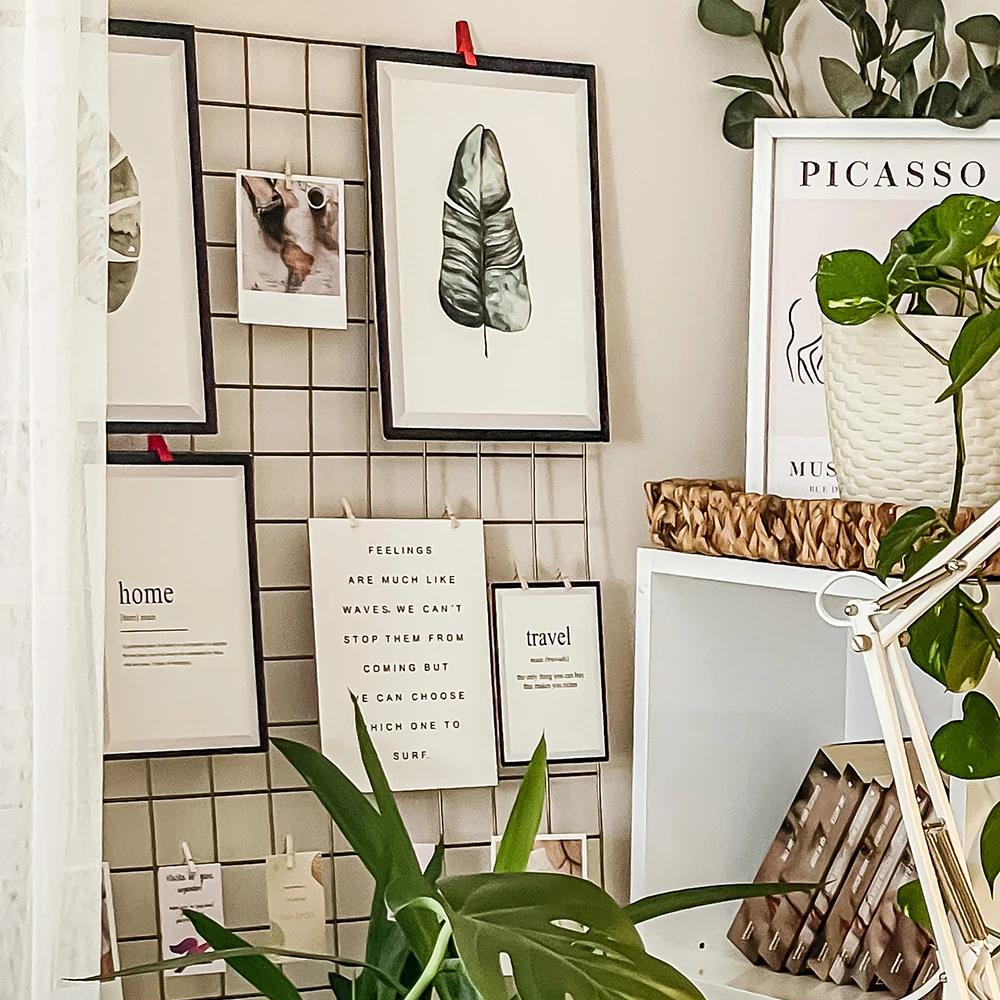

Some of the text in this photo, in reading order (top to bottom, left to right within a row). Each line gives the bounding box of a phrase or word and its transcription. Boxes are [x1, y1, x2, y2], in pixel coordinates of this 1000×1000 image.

[799, 160, 987, 188] PICASSO
[368, 546, 432, 555] FEELINGS
[348, 575, 456, 584] ARE MUCH LIKE
[118, 580, 174, 605] home
[397, 605, 414, 613] WE
[422, 604, 462, 613] CAN'T
[343, 633, 464, 644] STOP THEM FROM
[526, 625, 572, 646] travel
[363, 662, 449, 673] COMING BUT
[376, 693, 402, 702] CAN
[411, 691, 465, 701] CHOOSE
[365, 720, 461, 732] HICH ONE TO
